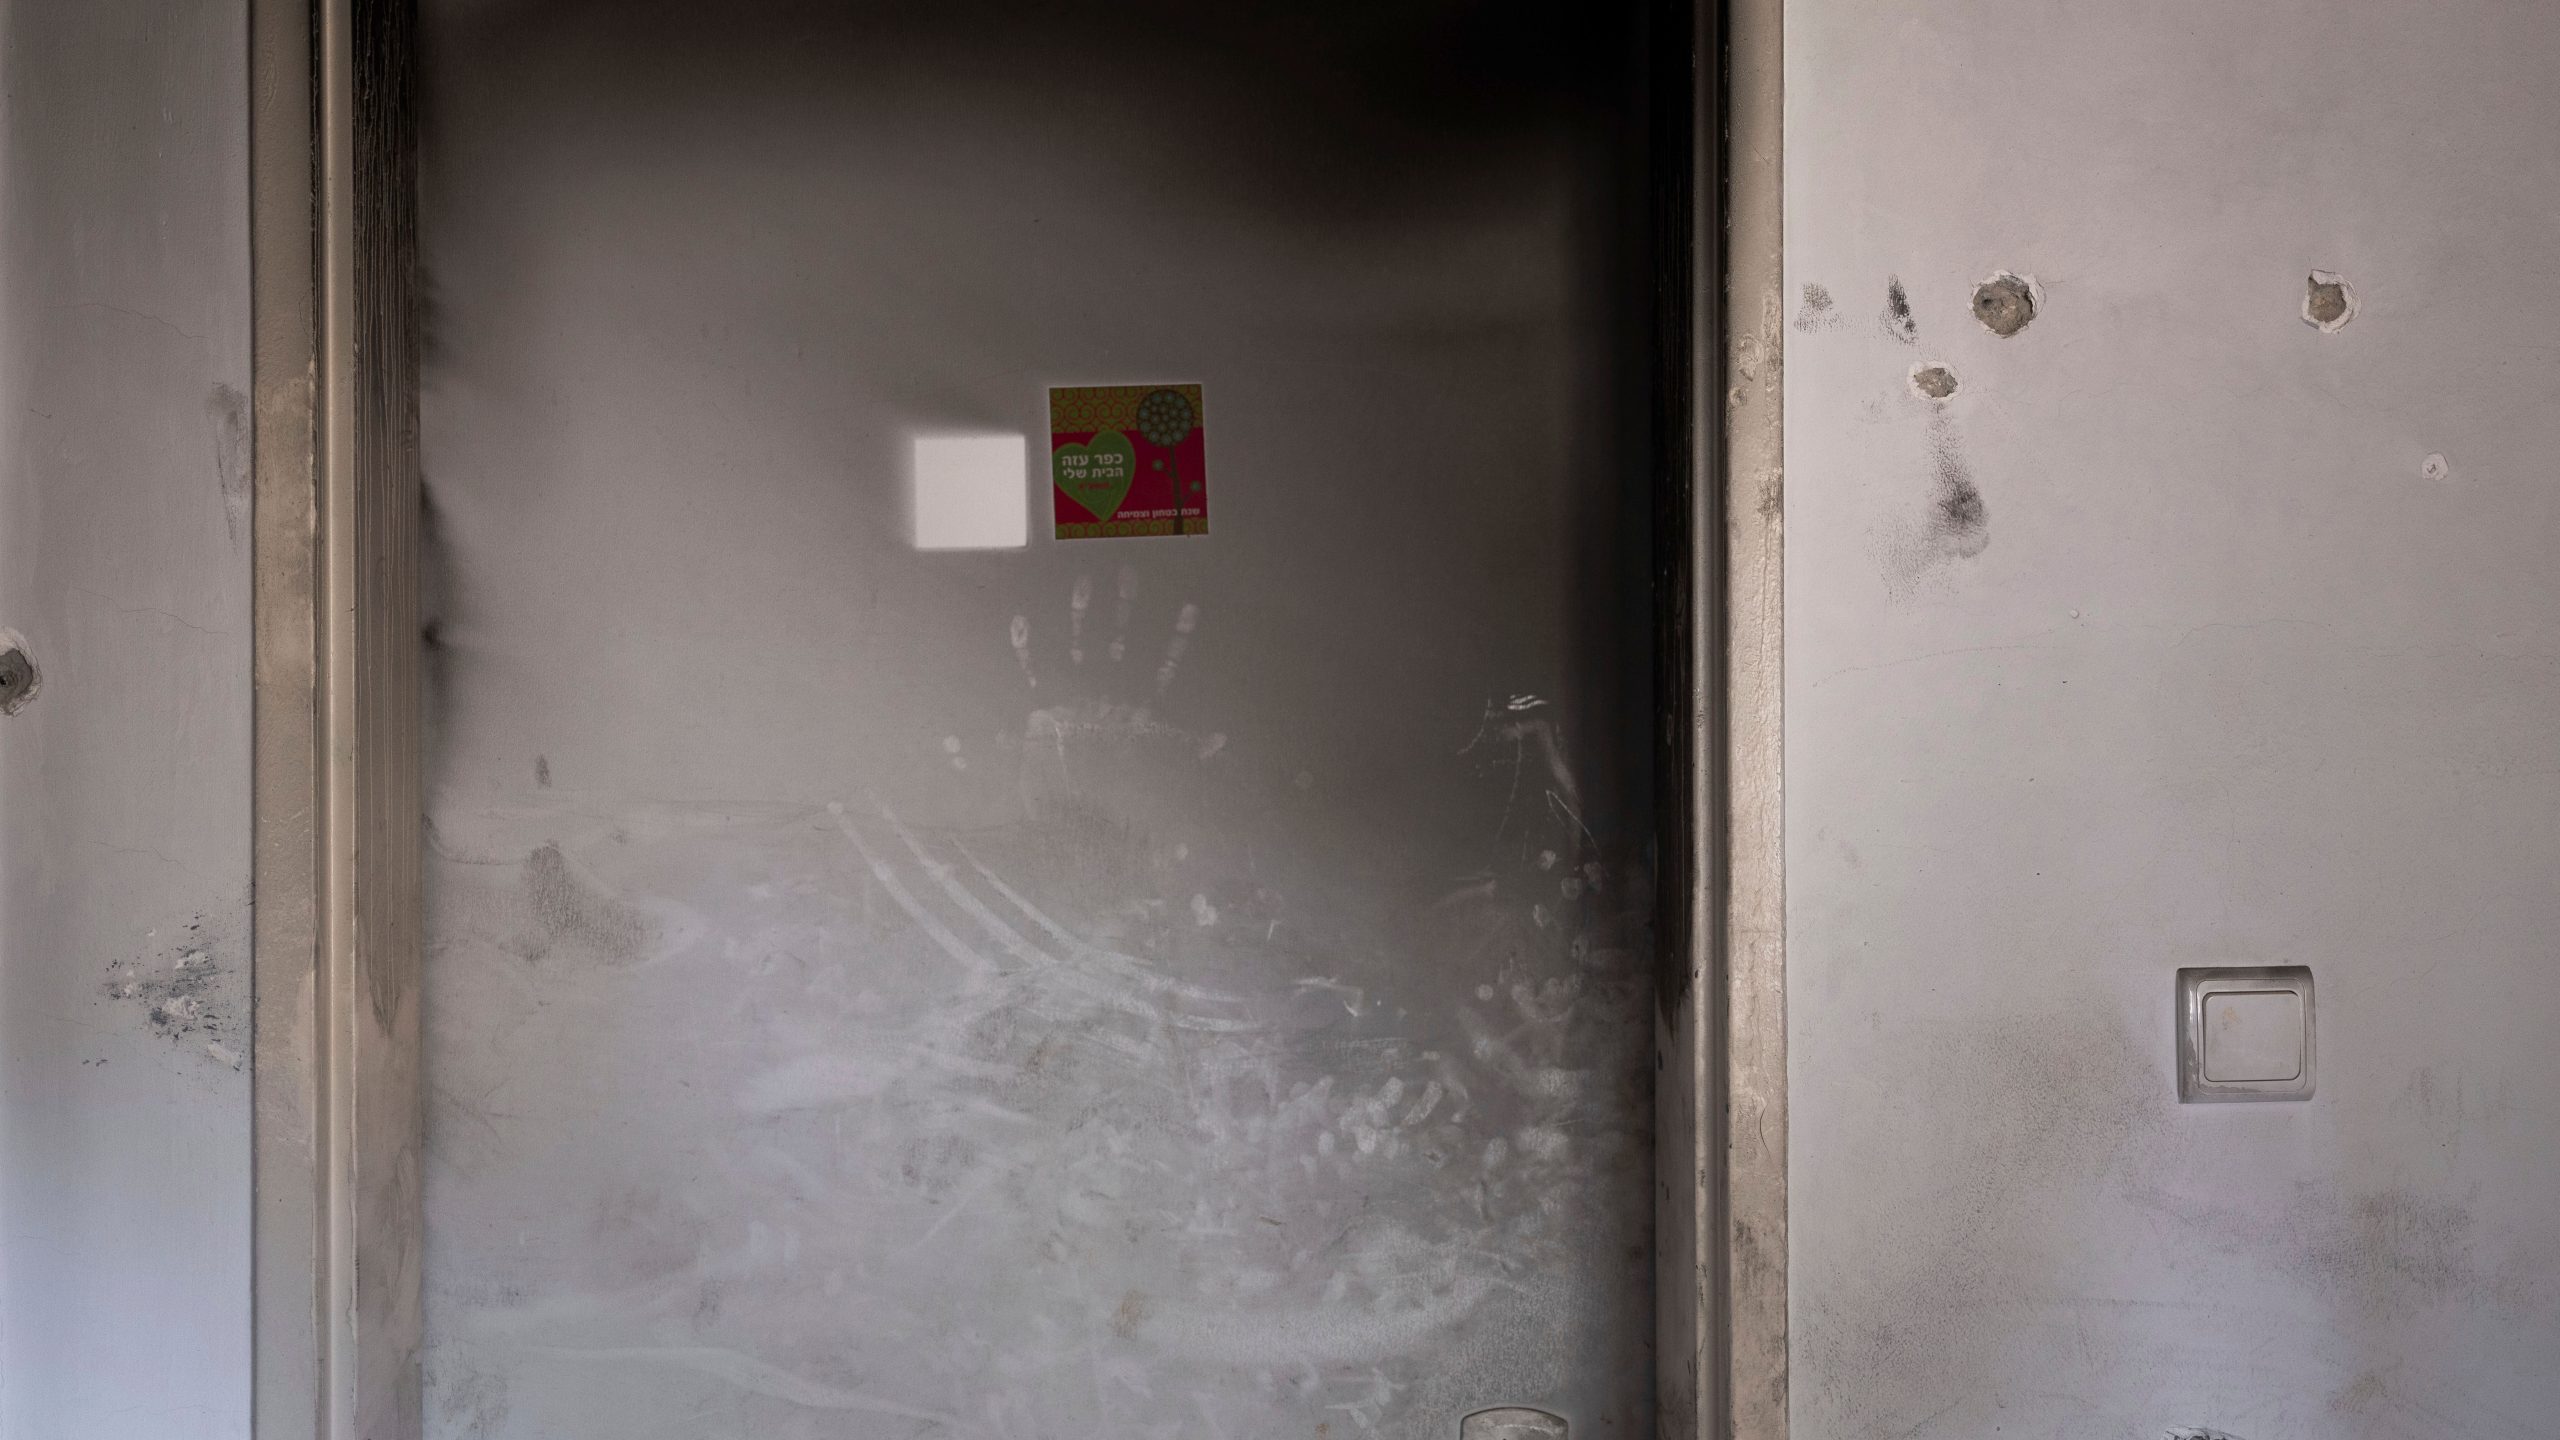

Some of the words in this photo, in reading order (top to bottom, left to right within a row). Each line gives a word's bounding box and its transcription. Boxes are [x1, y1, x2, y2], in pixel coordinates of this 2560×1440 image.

[1062, 455, 1089, 466] עזה
[1094, 453, 1123, 465] כפר
[1063, 467, 1087, 479] שלי
[1092, 467, 1124, 478] הבית
